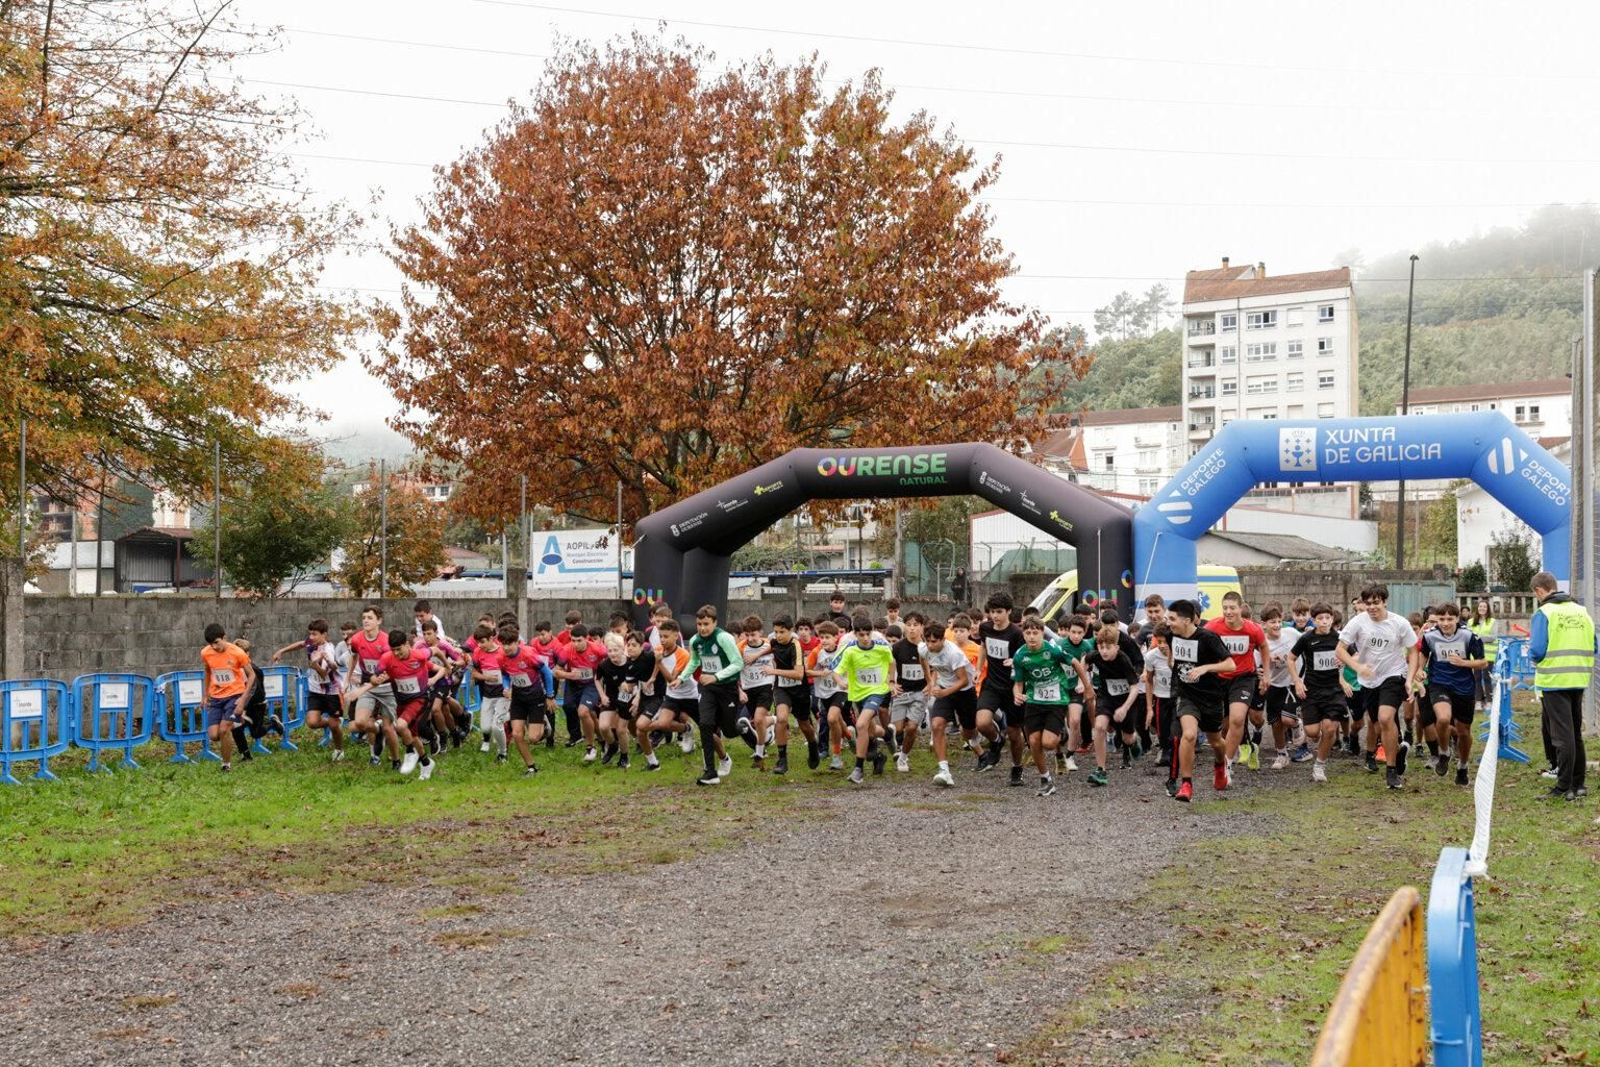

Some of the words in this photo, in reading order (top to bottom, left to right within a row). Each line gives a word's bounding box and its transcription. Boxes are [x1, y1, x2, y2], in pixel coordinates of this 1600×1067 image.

[1325, 427, 1396, 445] XUNTA
[1325, 448, 1351, 464] DE
[1355, 443, 1442, 463] GALICIA
[817, 453, 947, 477] OURENSE
[1180, 448, 1225, 490] DEPORTE
[900, 475, 947, 486] NATURAL
[1187, 459, 1226, 496] GALEGO
[1528, 460, 1571, 500] DEPORT
[1521, 468, 1565, 506] GALEGO
[989, 645, 1003, 657] 931
[1371, 637, 1389, 647] 907
[1175, 645, 1192, 659] 904
[860, 674, 877, 683] 921
[1038, 689, 1054, 699] 927
